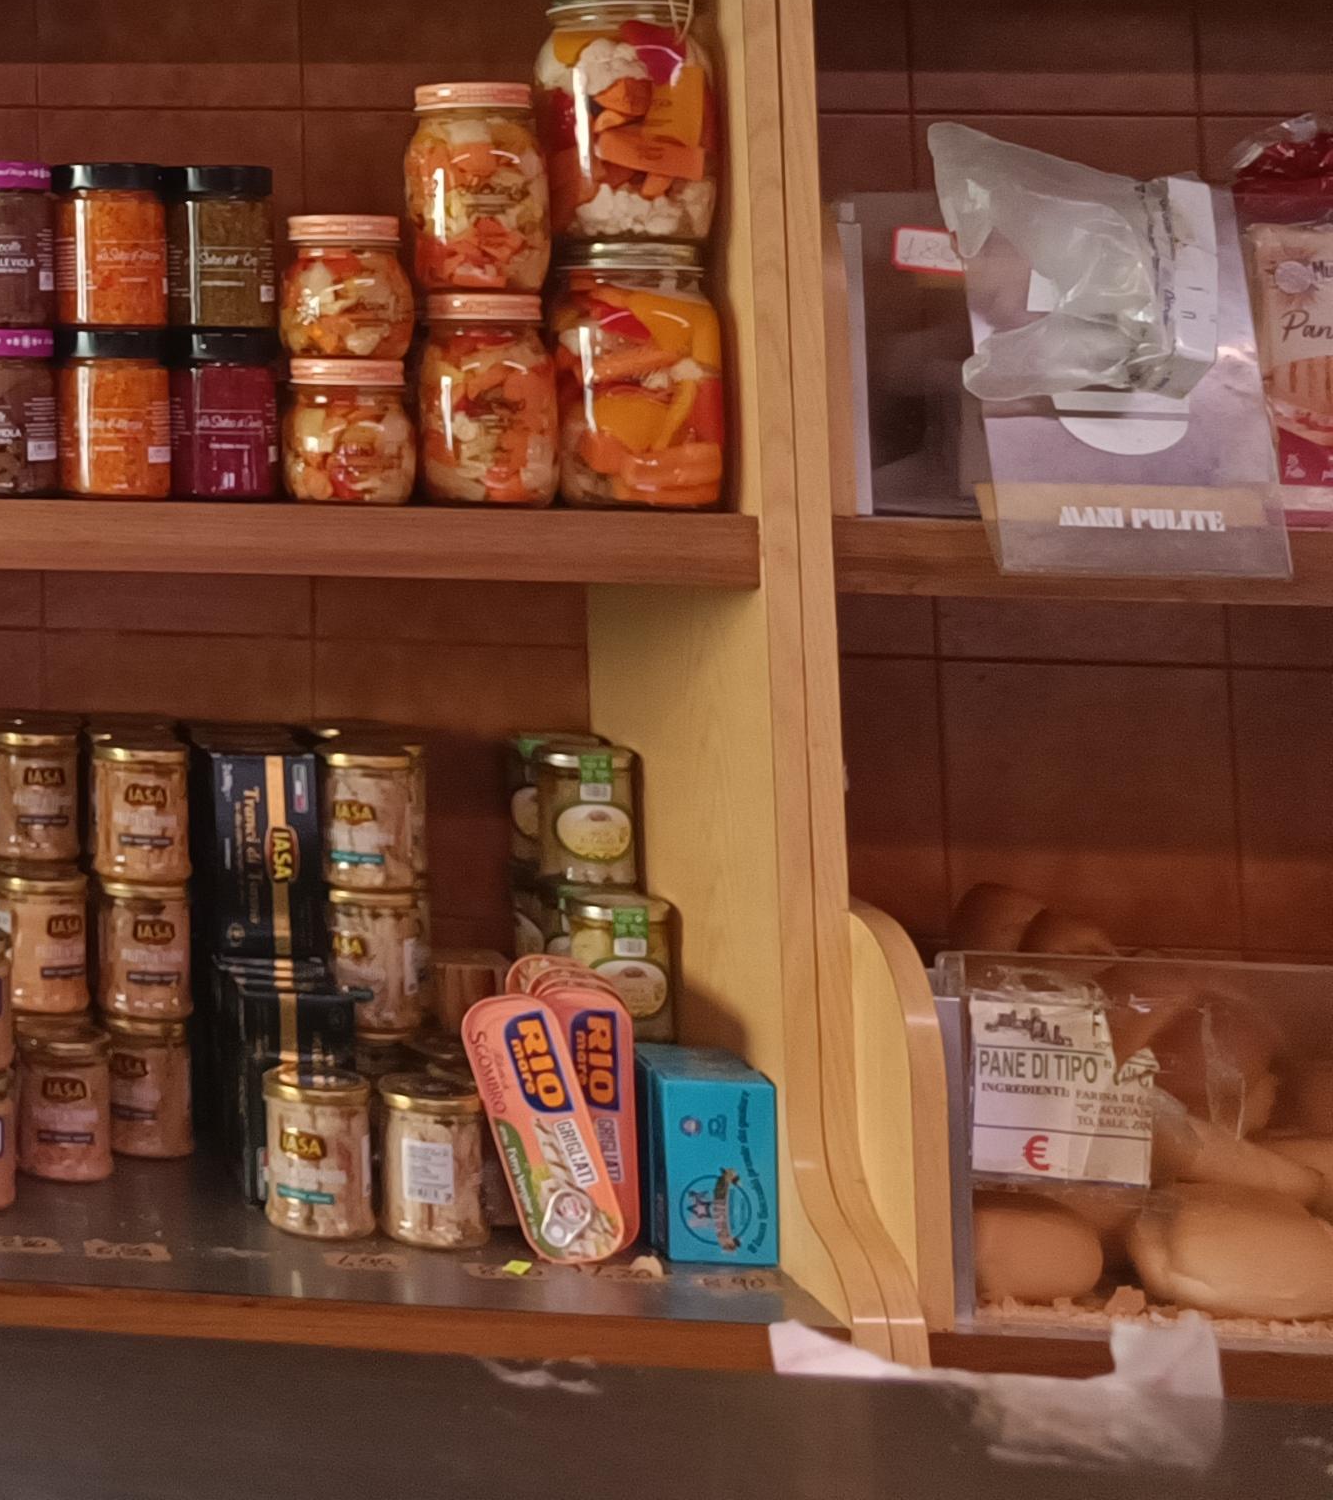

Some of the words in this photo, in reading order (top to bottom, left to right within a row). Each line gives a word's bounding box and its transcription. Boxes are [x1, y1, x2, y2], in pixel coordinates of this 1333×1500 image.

[1130, 508, 1227, 532] PULITE
[129, 786, 167, 805] IASA
[270, 828, 293, 881] IASA
[137, 922, 175, 942] IASA
[470, 1030, 507, 1115] SGOMBRO
[510, 1038, 536, 1095] mare
[517, 1019, 566, 1108] RIO
[587, 1016, 616, 1104] RIO
[979, 1050, 1026, 1079] PANE
[1033, 1052, 1049, 1079] DI
[1053, 1056, 1098, 1084] TIPO
[45, 1079, 85, 1100] IASA
[284, 1133, 323, 1158] IASA
